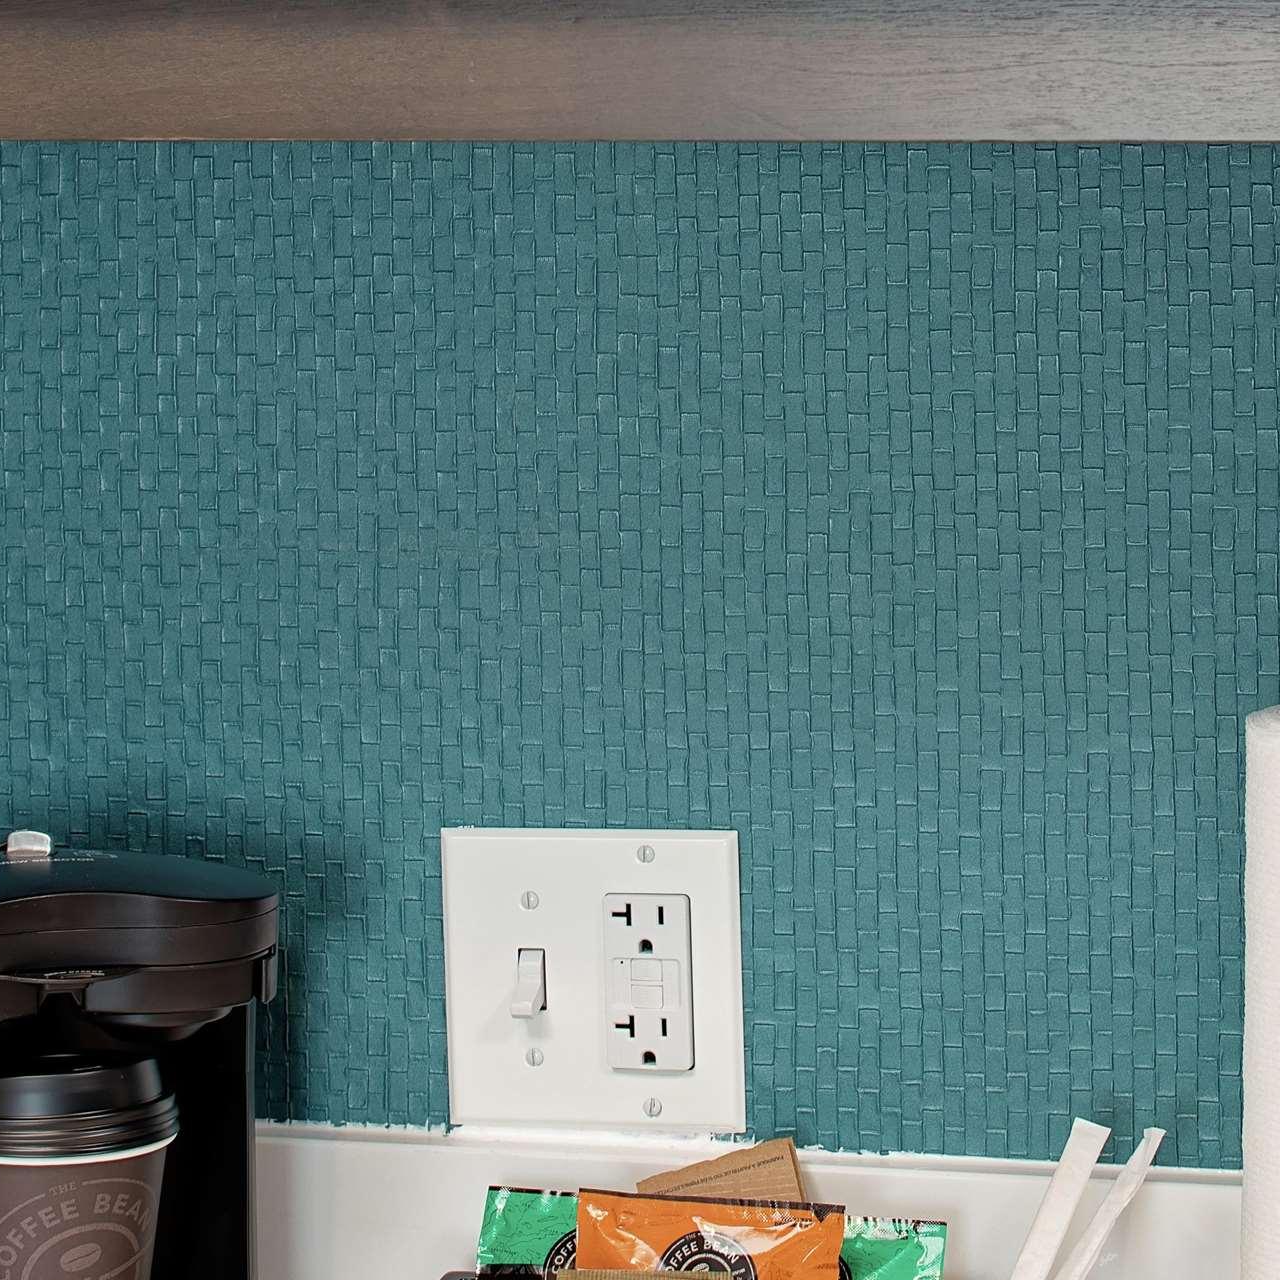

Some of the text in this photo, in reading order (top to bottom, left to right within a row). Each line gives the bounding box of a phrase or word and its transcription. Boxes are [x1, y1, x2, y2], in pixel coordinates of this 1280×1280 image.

[48, 1181, 78, 1196] THE
[93, 1192, 152, 1232] BEAN
[551, 1238, 577, 1274] COFF
[664, 1240, 740, 1272] OFFEE BEAN
